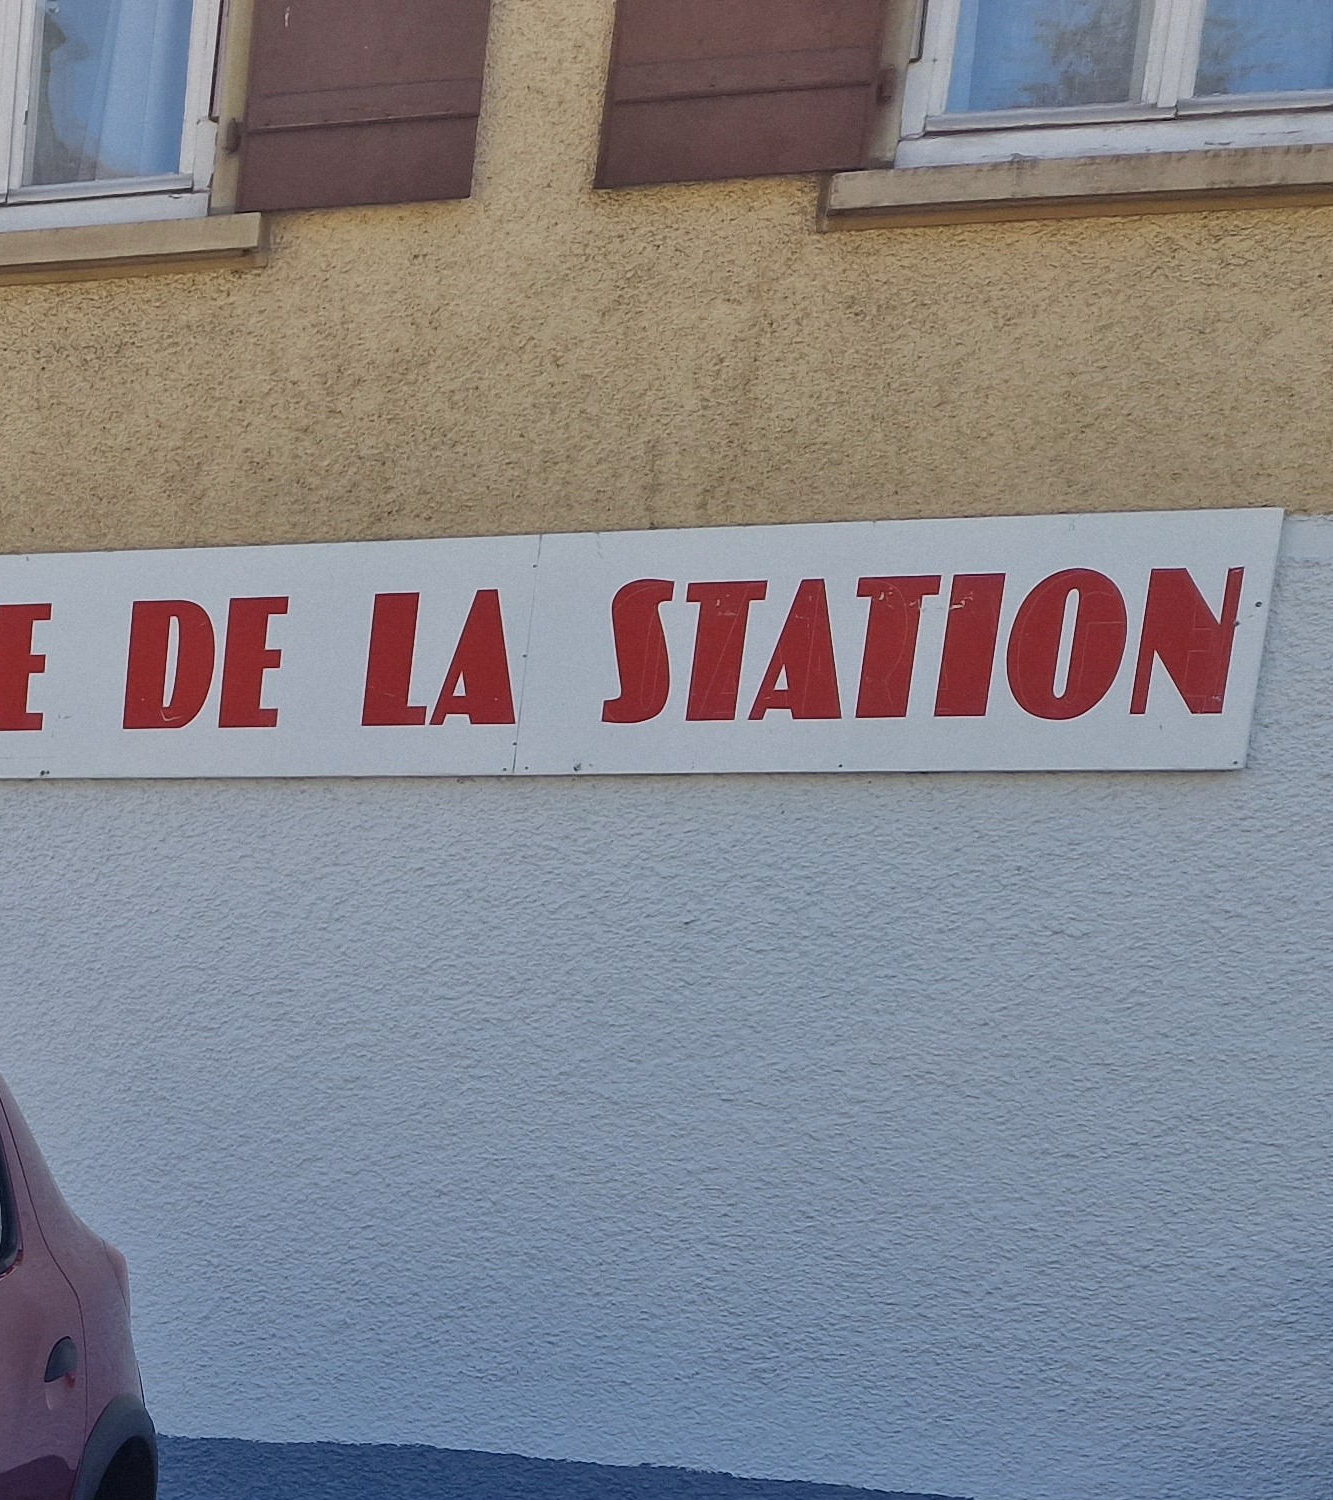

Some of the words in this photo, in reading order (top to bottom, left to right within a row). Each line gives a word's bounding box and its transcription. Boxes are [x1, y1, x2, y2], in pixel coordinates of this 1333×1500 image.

[122, 596, 290, 730] DE
[361, 589, 517, 726] LA
[600, 565, 1246, 725] STATION
